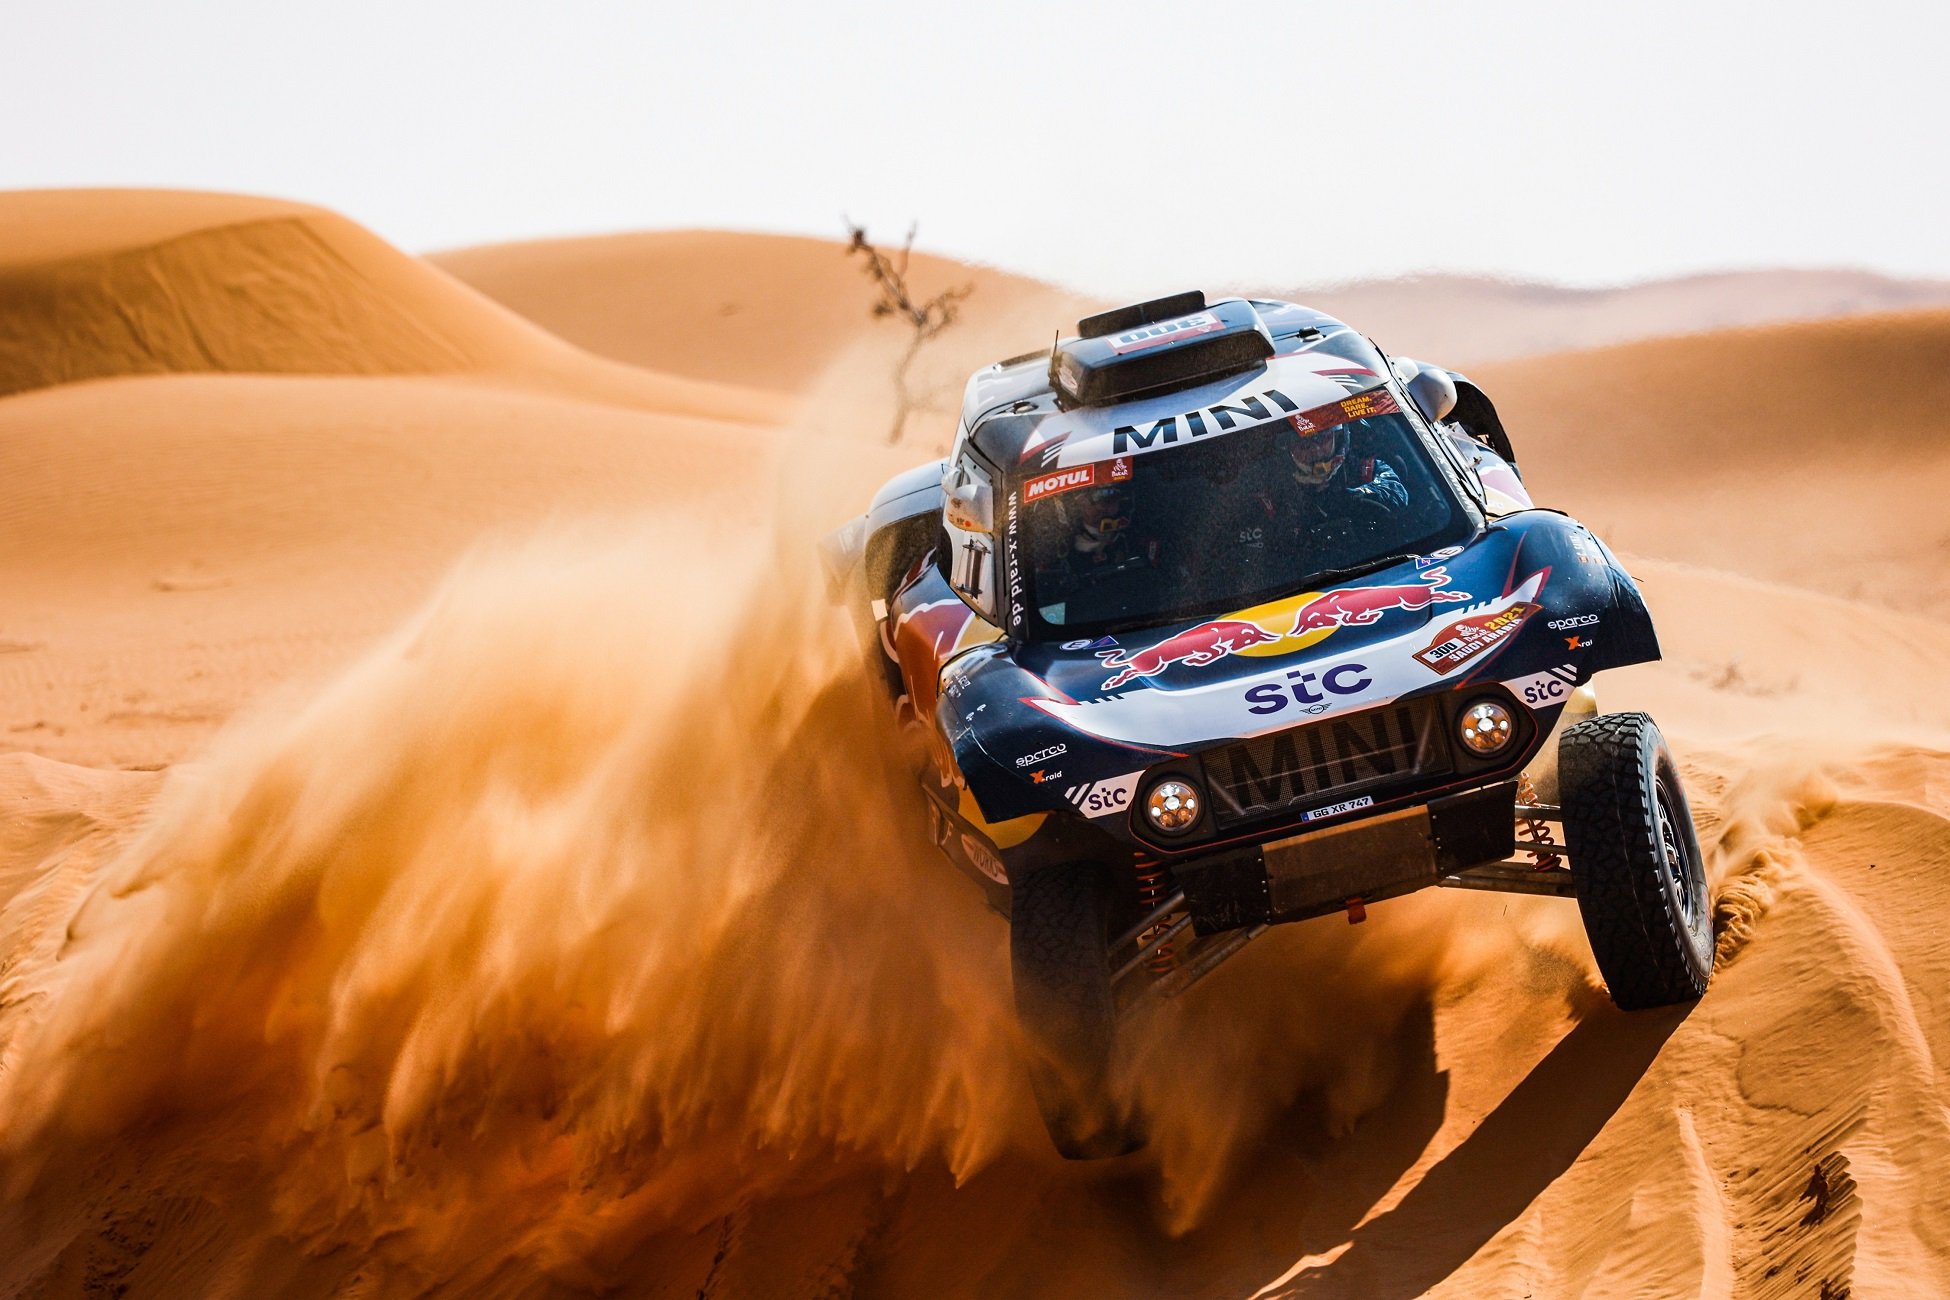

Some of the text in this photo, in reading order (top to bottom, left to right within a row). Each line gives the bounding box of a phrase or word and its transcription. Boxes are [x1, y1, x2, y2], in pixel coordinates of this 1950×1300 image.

[1113, 389, 1299, 455] MINI
[1348, 408, 1366, 418] LIVE
[1028, 470, 1090, 497] MOTUL
[1009, 491, 1024, 627] www.x-raid.de
[1484, 606, 1526, 630] 2021
[1547, 614, 1600, 631] sparco
[1430, 642, 1458, 659] 300
[1448, 619, 1523, 662] SAUDI ARABIA
[1245, 664, 1373, 715] stc
[1524, 680, 1564, 704] stc
[1015, 743, 1068, 769] sparco
[1228, 706, 1416, 808] MINI
[1088, 787, 1128, 811] stc
[1313, 797, 1369, 818] GG XR 747
